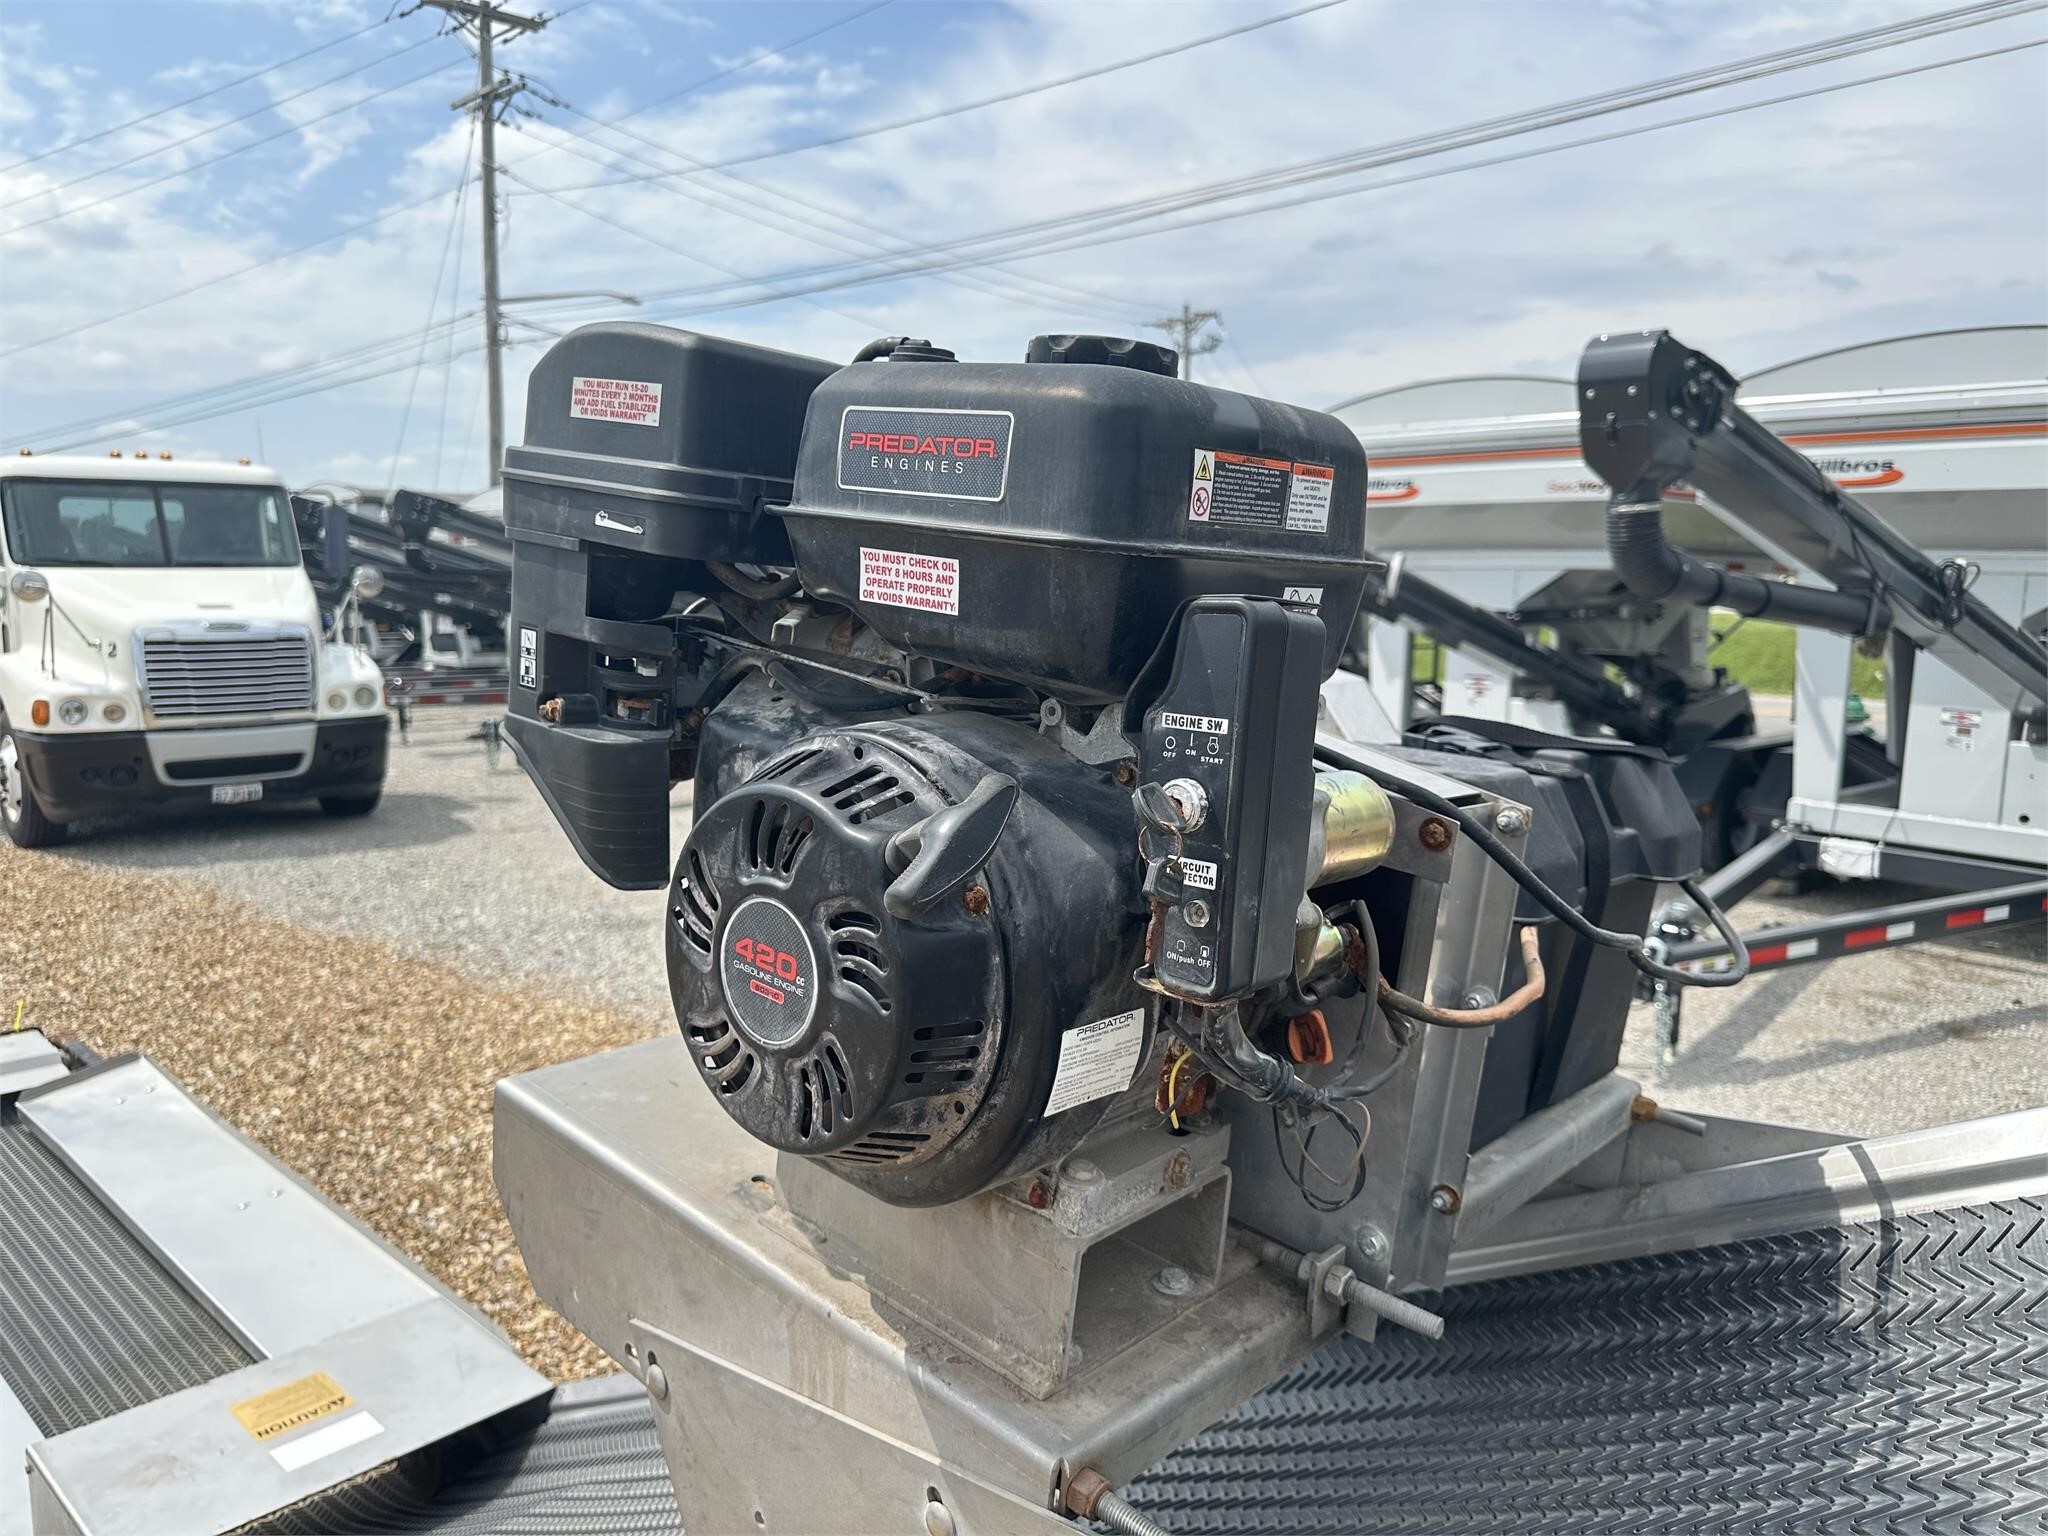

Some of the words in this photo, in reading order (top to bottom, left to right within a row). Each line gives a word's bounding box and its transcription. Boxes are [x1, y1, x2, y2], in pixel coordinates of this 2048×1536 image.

[574, 388, 599, 398] MINUTES
[601, 390, 621, 400] EVERY
[623, 392, 627, 400] 3
[629, 393, 658, 403] MONTHS
[583, 380, 594, 388] YOU
[596, 381, 613, 389] MUST
[615, 383, 628, 391] RUN
[631, 384, 648, 393] 15-20
[574, 397, 585, 406] AND
[587, 399, 599, 407] ADD
[601, 400, 615, 409] FUEL
[618, 401, 656, 413] STABILIZER
[580, 407, 588, 416] OR
[591, 409, 608, 417] VOIDS
[610, 410, 646, 422] WARRANTY
[850, 432, 996, 459] PREDATOR
[871, 456, 963, 474] ENGINES
[863, 551, 880, 561] YOU
[882, 553, 906, 566] MUST
[909, 557, 939, 570] CHECK
[942, 562, 957, 573] OIL
[865, 564, 892, 577] EVERY
[895, 568, 900, 578] 8
[903, 570, 933, 582] HOURS
[935, 574, 954, 585] AND
[866, 577, 905, 591] OPERATE
[907, 583, 952, 599] PROPERLY
[863, 589, 874, 599] OR
[877, 591, 903, 603] VOIDS
[905, 595, 955, 612] WARRANTY
[107, 641, 117, 658] 2
[1164, 715, 1203, 730] ENGINE
[1206, 720, 1225, 733] SW.
[1200, 756, 1224, 764] START
[1180, 861, 1211, 875] IRCUIT
[1184, 872, 1214, 887] TECTOR
[1166, 951, 1194, 965] ON/push
[1197, 958, 1211, 968] OFF
[733, 960, 773, 983] GASOLINE
[773, 978, 804, 997] ENGINE
[1077, 1014, 1134, 1037] PREDATOR
[257, 1403, 331, 1438] CAUTION
